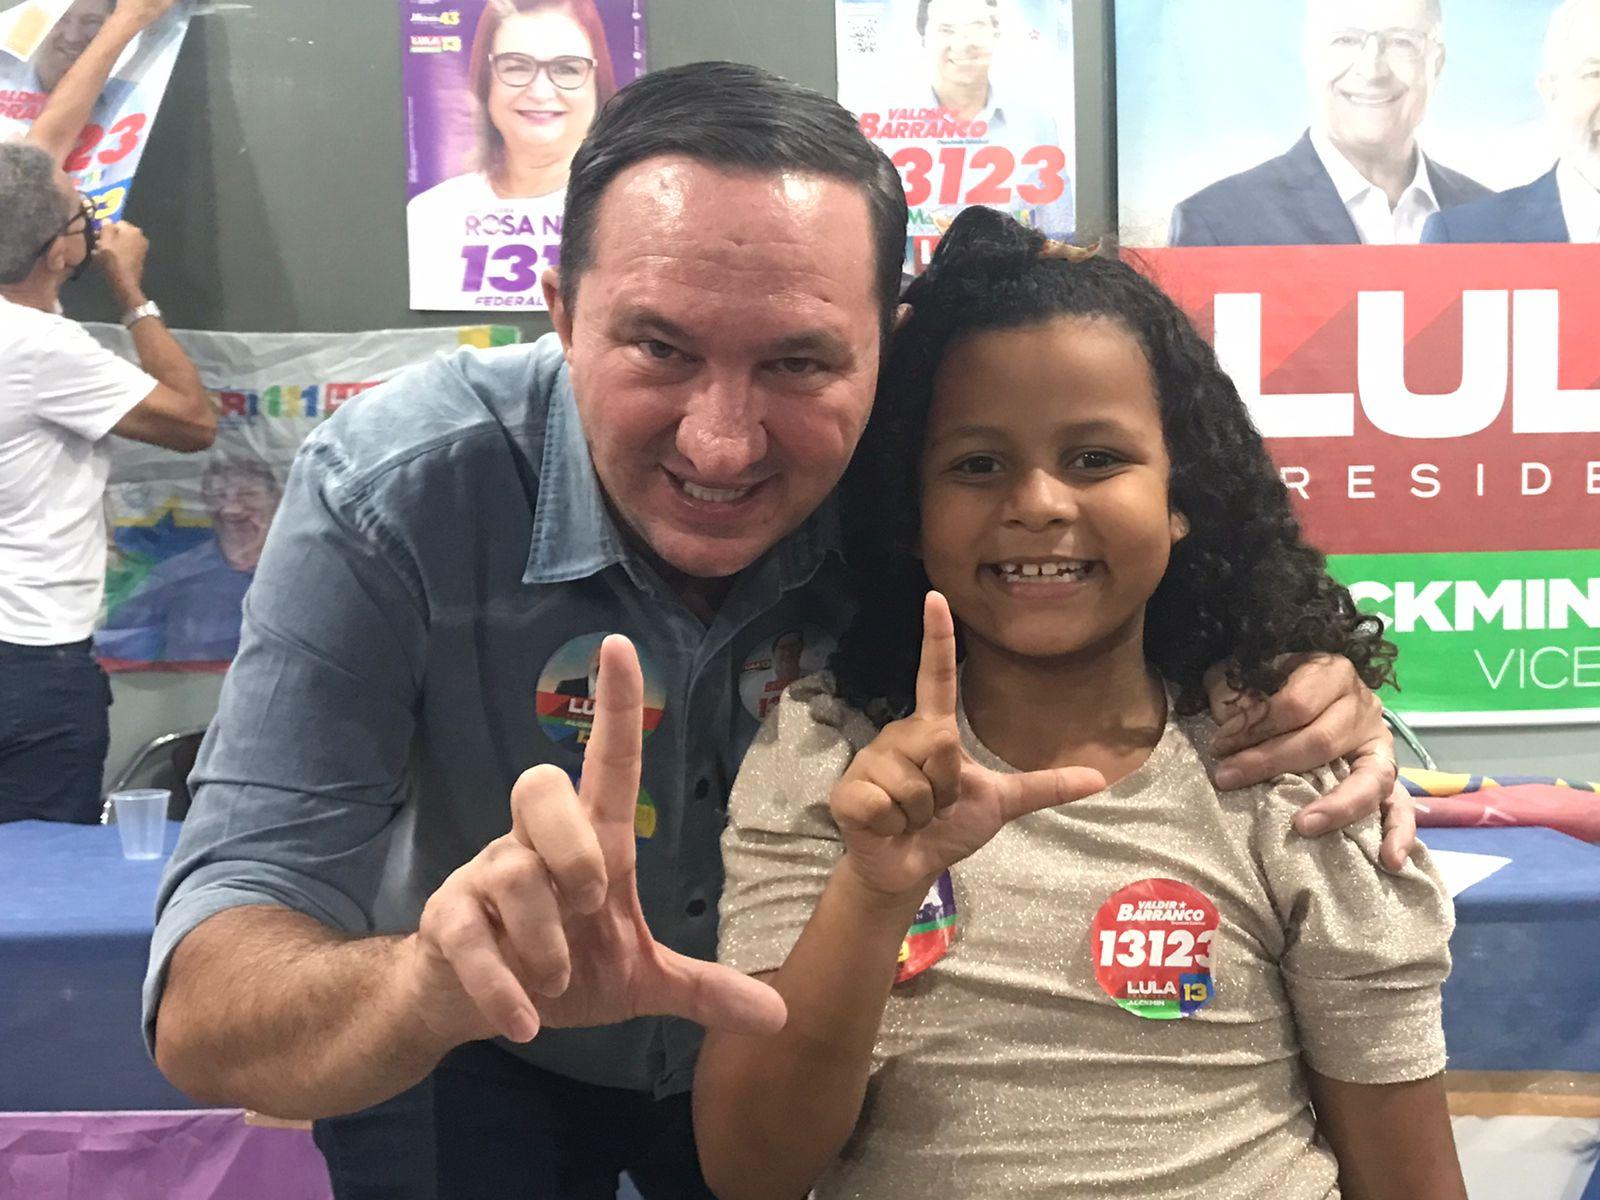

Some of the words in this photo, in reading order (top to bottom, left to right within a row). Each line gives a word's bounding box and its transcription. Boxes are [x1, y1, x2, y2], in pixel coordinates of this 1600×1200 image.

[859, 112, 988, 139] BARRANCO
[465, 214, 535, 236] ROSA
[475, 296, 543, 306] FEDERAL
[1213, 289, 1600, 438] LUL
[1474, 645, 1600, 690] VICE
[1117, 903, 1205, 921] BARRANCO
[1138, 900, 1177, 909] VALDIR
[1100, 929, 1213, 967] 13123
[1127, 981, 1177, 994] LULA
[1183, 983, 1207, 1001] 13
